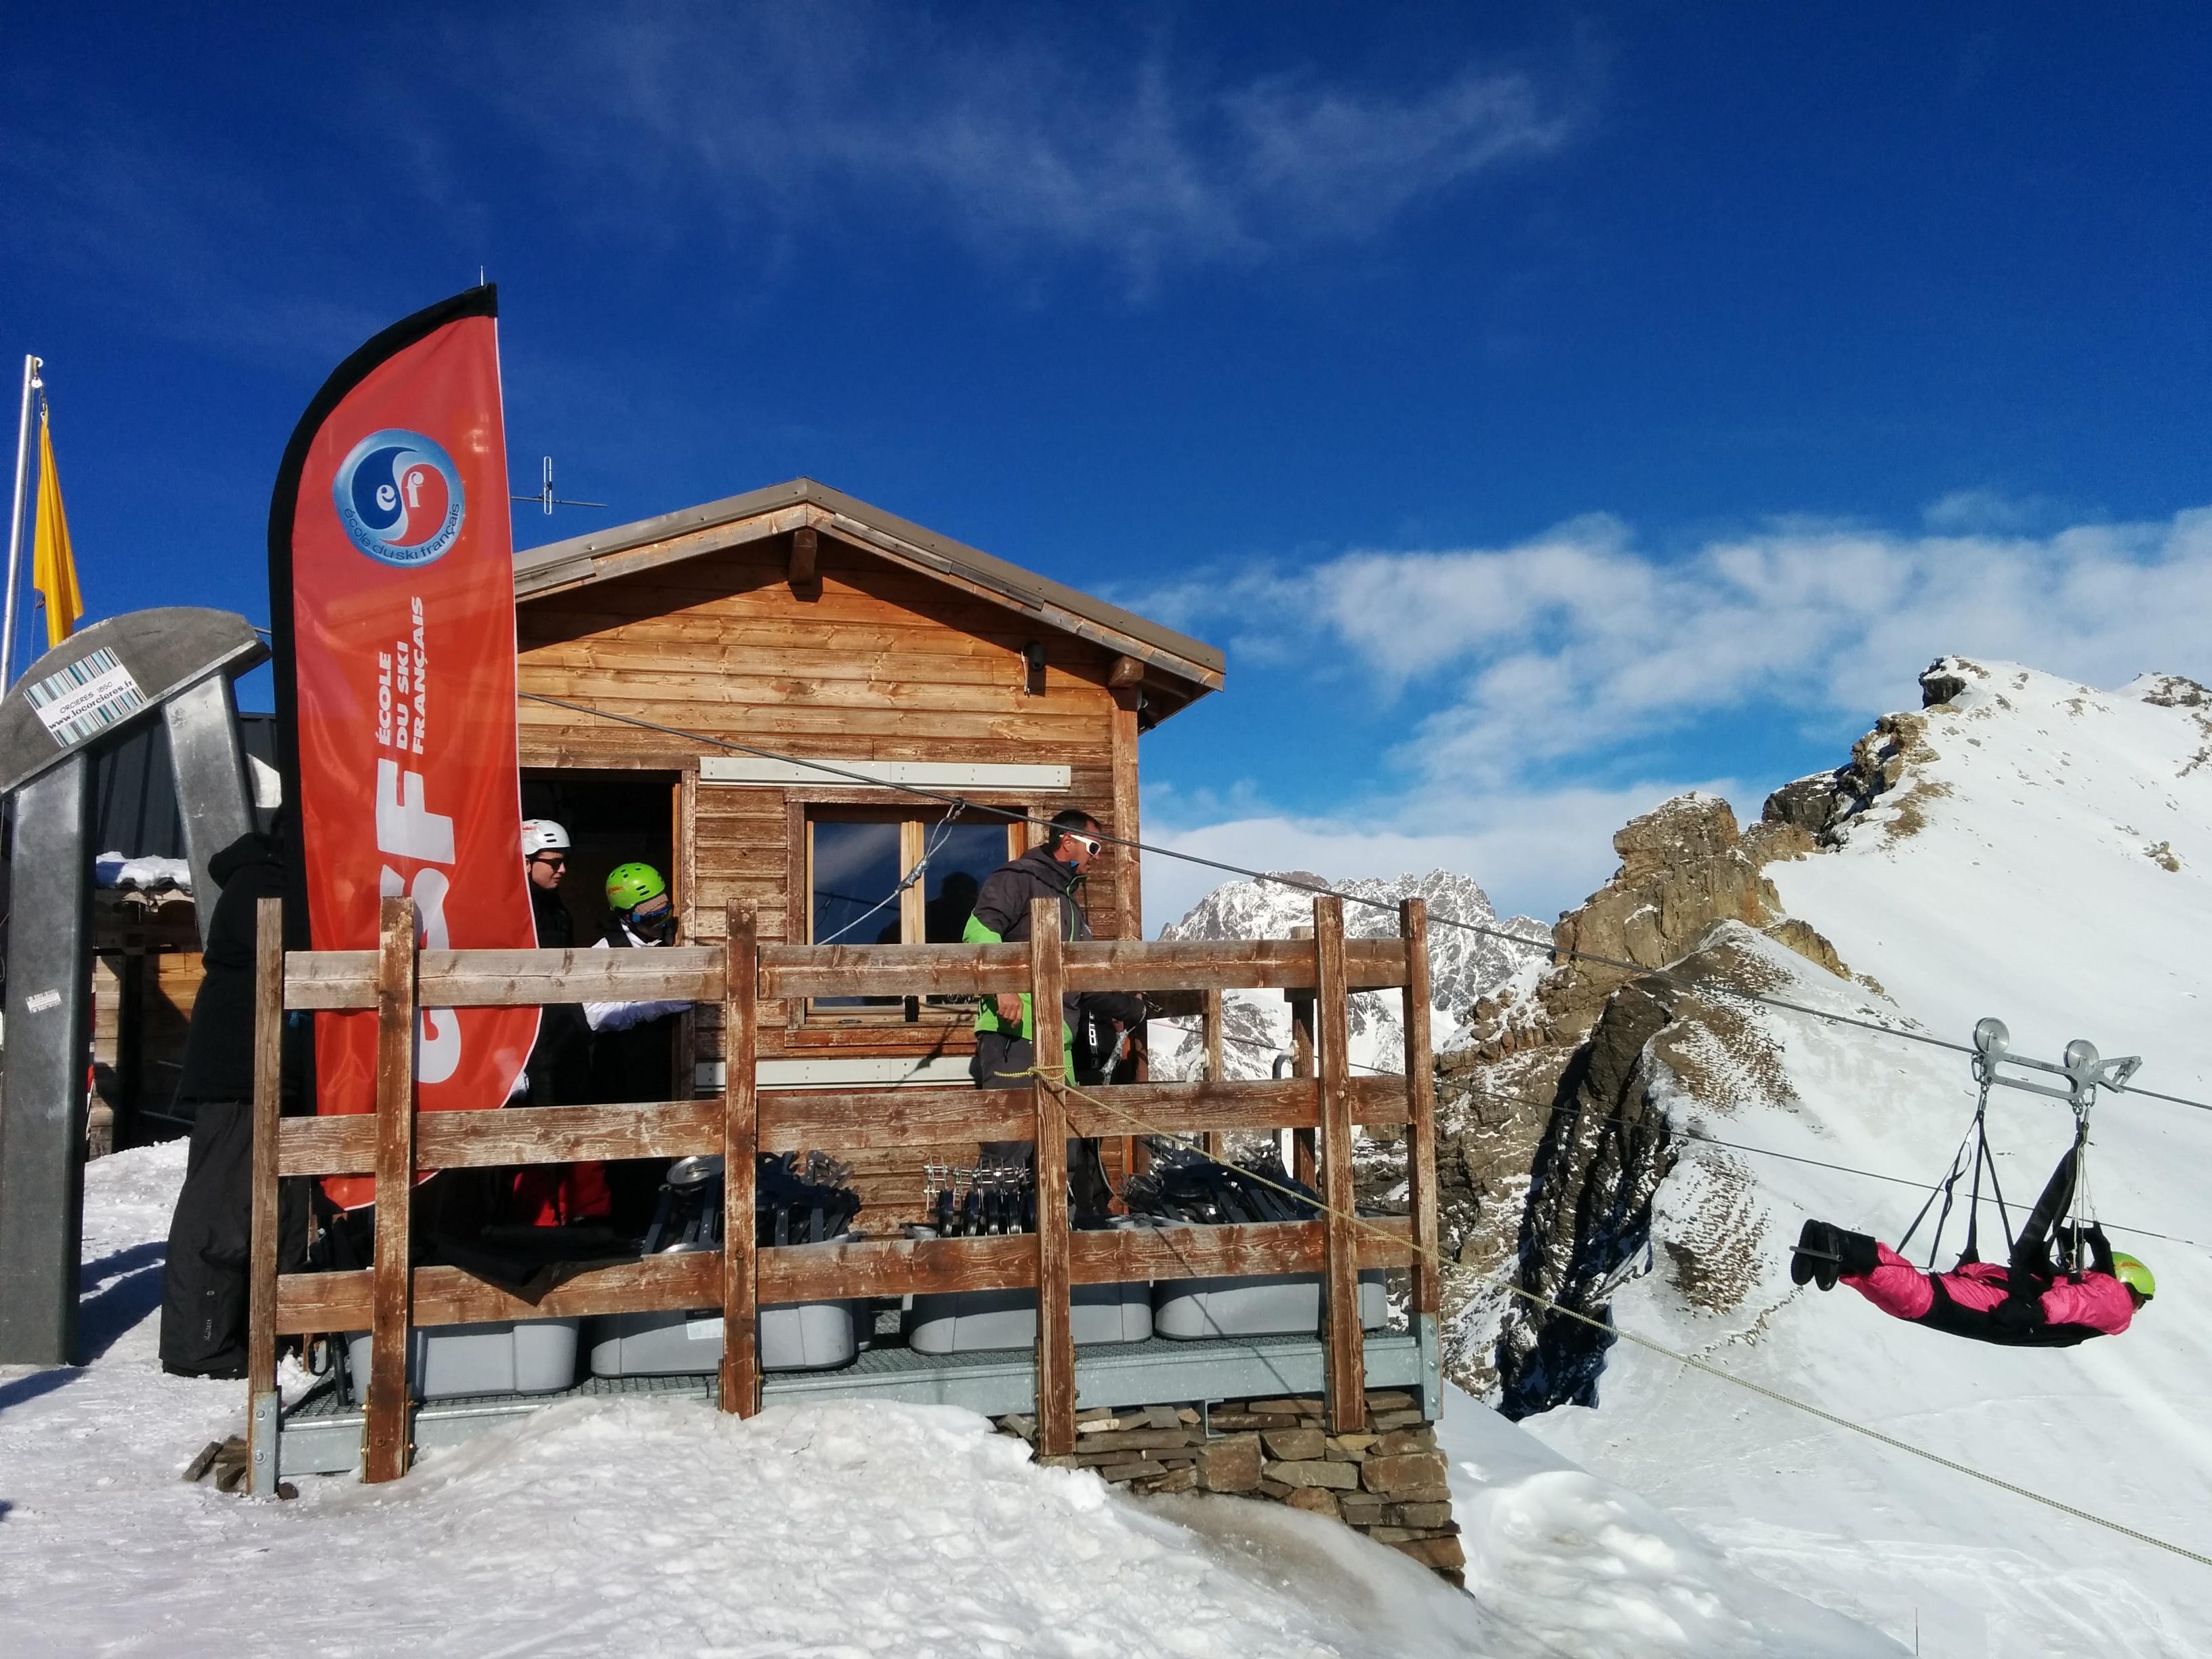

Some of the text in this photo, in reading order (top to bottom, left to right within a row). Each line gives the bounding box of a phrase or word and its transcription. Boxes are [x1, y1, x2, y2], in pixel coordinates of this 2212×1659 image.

[344, 504, 460, 560] école du ski français
[48, 680, 134, 731] www.locorcieres.fr
[60, 692, 95, 714] ORCIERES
[375, 651, 392, 746] ÉCOLE
[396, 641, 409, 750] DU SKI
[411, 596, 428, 755] FRANÇAIS
